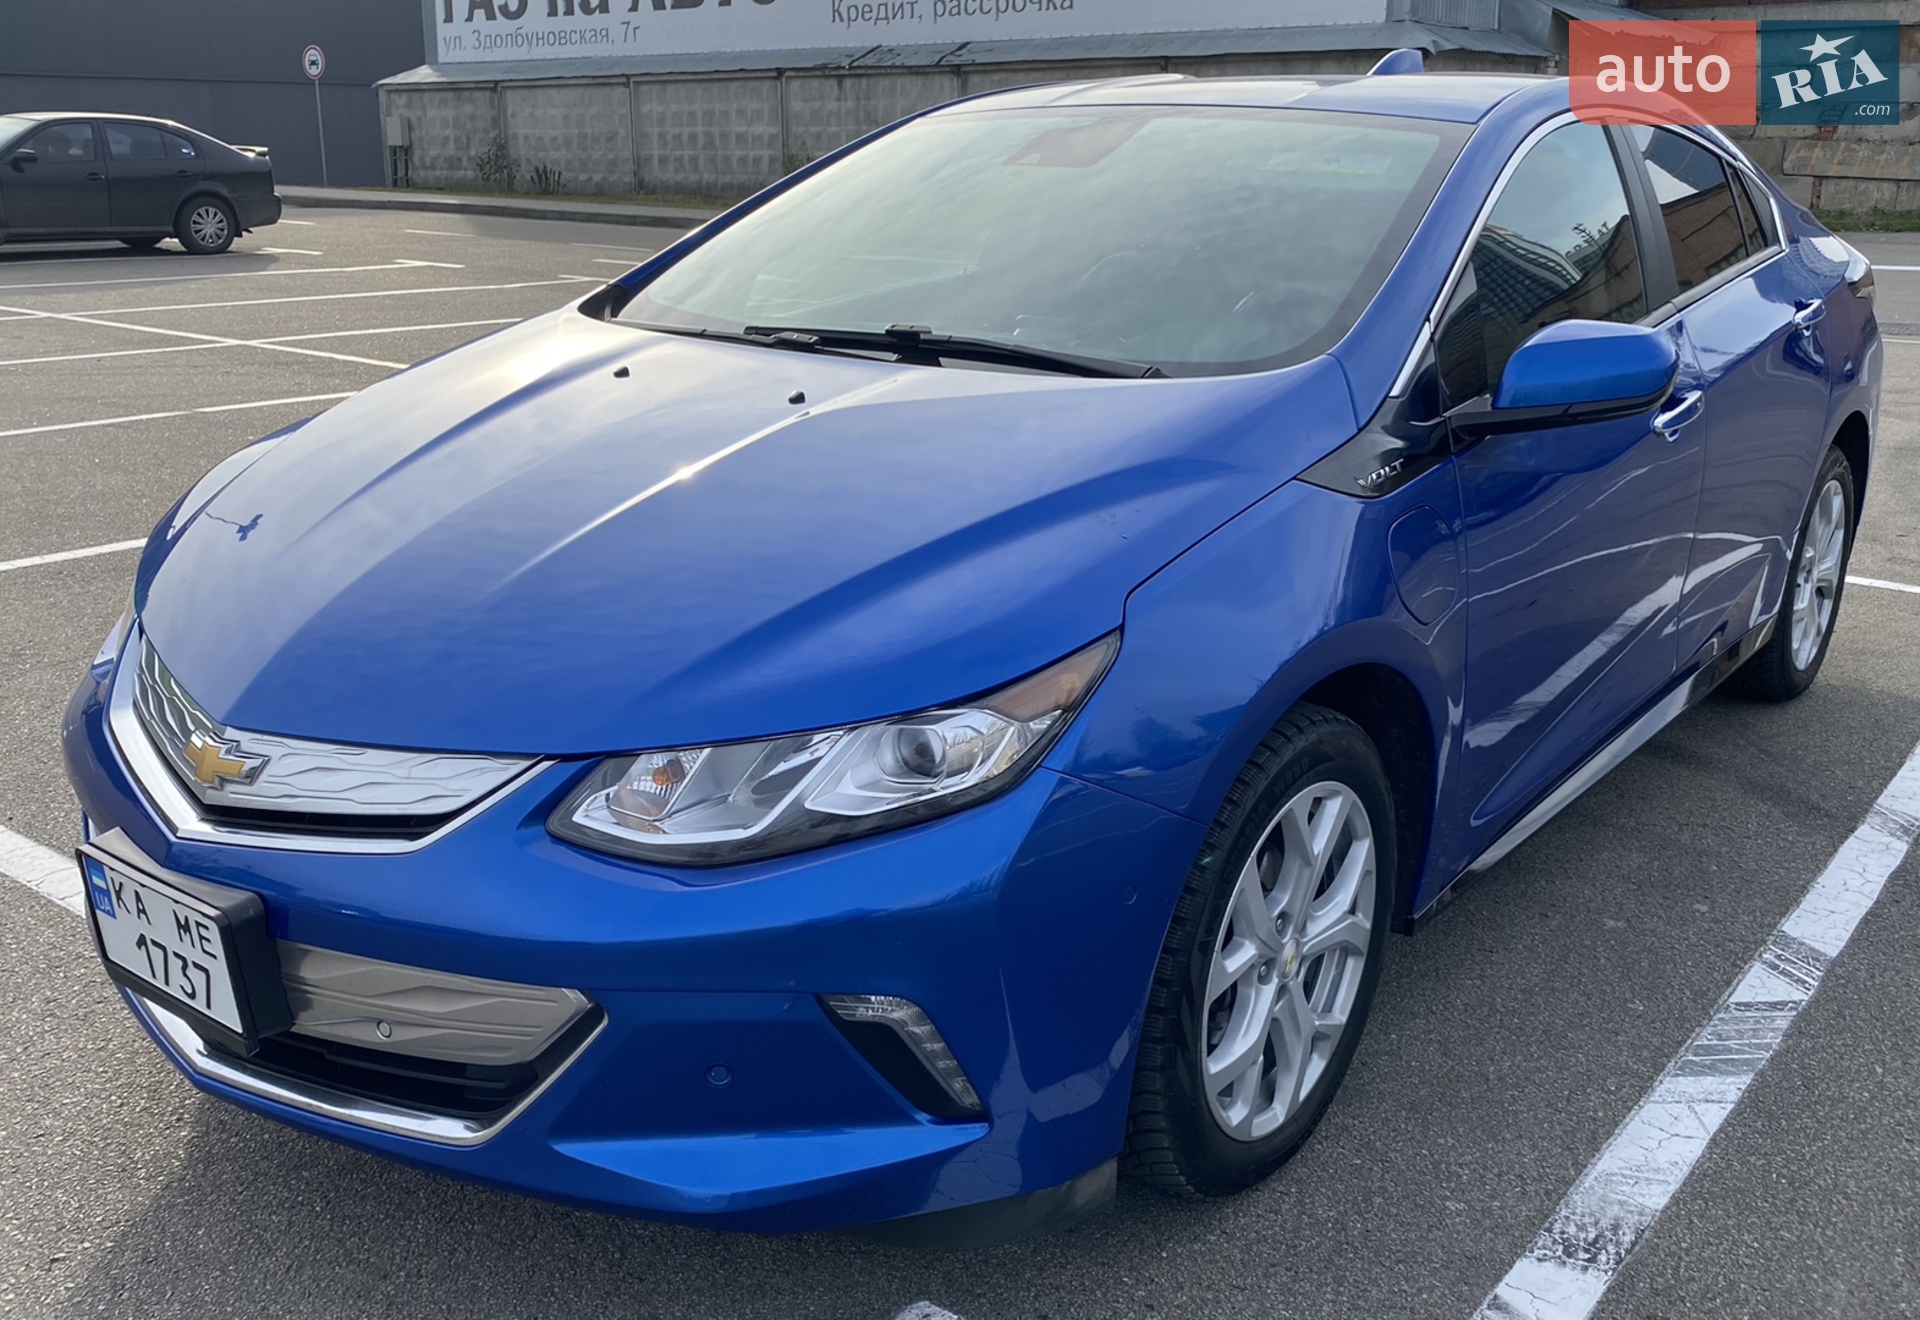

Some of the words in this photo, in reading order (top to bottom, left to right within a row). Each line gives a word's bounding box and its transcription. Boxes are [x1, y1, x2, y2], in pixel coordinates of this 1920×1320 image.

[831, 0, 922, 29] Кредит,
[443, 35, 467, 56] ул.
[471, 25, 615, 53] Здолбуновская,
[620, 20, 640, 43] 7г
[1356, 457, 1404, 487] VOLT
[94, 894, 114, 915] UA
[135, 932, 213, 1011] 1737
